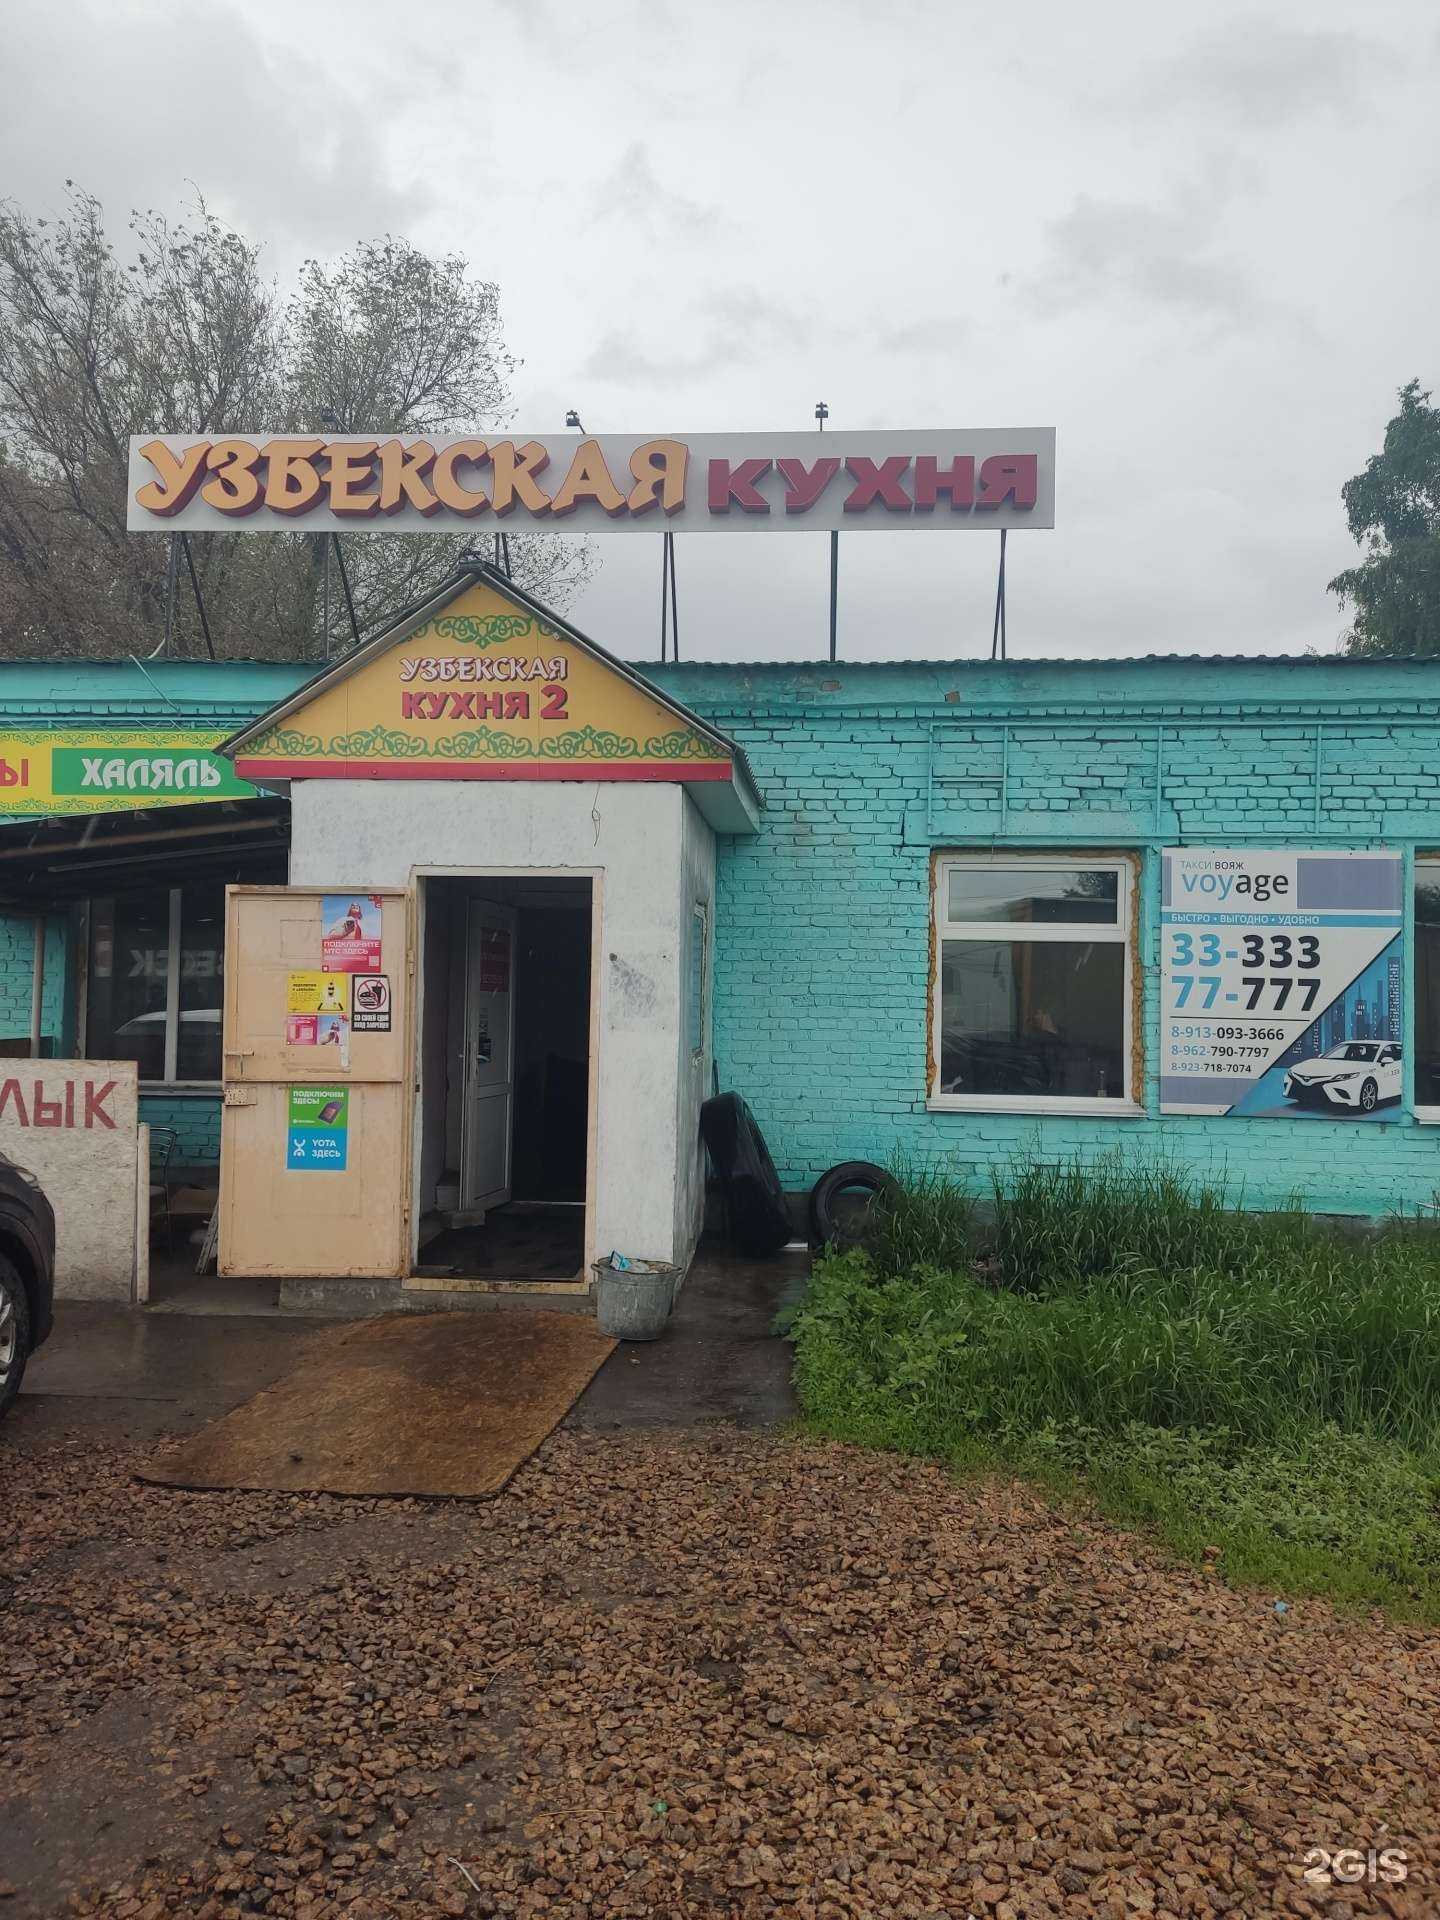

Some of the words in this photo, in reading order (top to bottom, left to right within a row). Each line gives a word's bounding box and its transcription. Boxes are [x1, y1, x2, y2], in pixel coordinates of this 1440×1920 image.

[135, 438, 690, 518] УЗБЕКСКАЯ
[708, 453, 1037, 514] КУХНЯ
[400, 656, 569, 682] УЗБЕКСКАЯ
[401, 690, 530, 720] КУХНЯ
[540, 684, 569, 720] 2
[81, 757, 221, 790] ХАЛЯЛЬ
[1180, 860, 1212, 870] ТАКСИ
[1215, 860, 1244, 870] ВОЯЖ
[1182, 873, 1289, 901] voyage
[1171, 914, 1210, 923] БЫСТРО
[1220, 914, 1268, 924] ВЫГОДНО
[1278, 915, 1320, 925] УДОБНО
[1171, 933, 1321, 969] 33-333
[1171, 975, 1321, 1012] 77-777
[1171, 1026, 1285, 1040] 8-913-093-3666
[1171, 1045, 1269, 1058] 8-962-790-7797
[1171, 1063, 1252, 1073] 8-923-718-7074
[311, 1150, 341, 1158] ЗДЕСЬ
